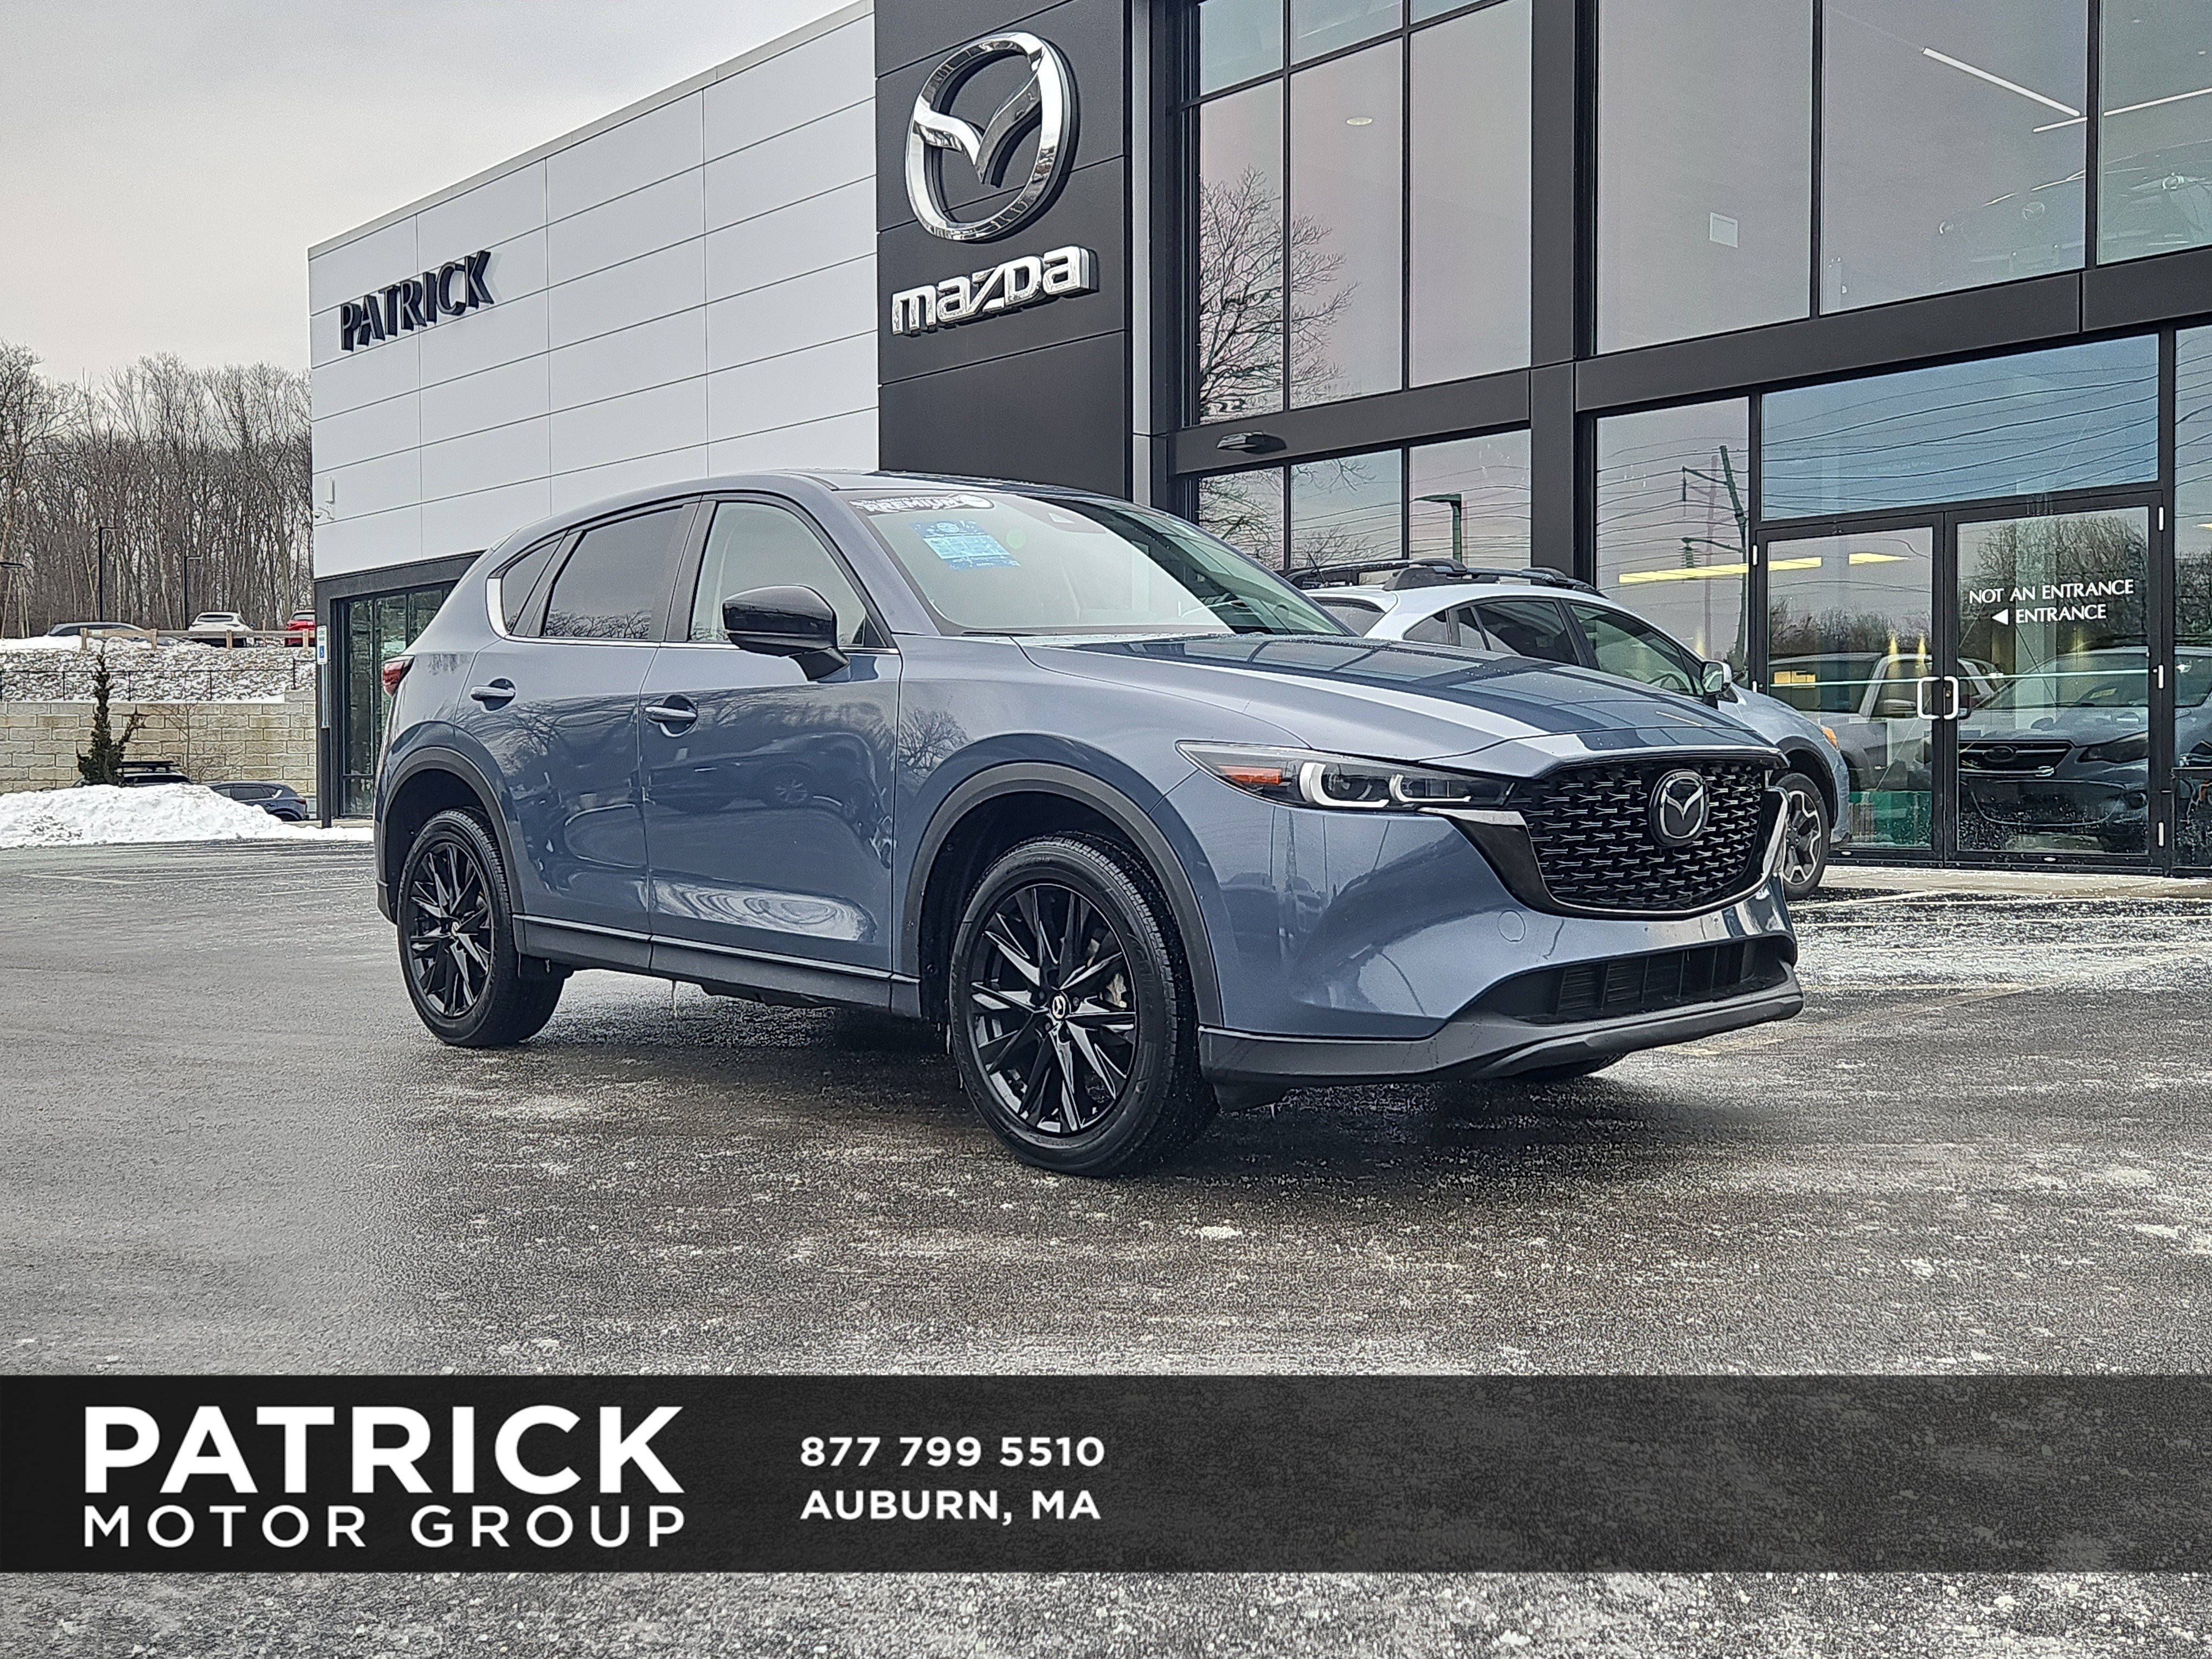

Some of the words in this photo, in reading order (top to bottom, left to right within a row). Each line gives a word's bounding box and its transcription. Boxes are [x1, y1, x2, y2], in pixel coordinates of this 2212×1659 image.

[340, 250, 495, 351] PATRICK
[1969, 588, 2004, 604] NOT
[2010, 586, 2036, 602] AN
[2042, 579, 2134, 600] ENTRANCE
[2016, 604, 2107, 624] ENTRANCE
